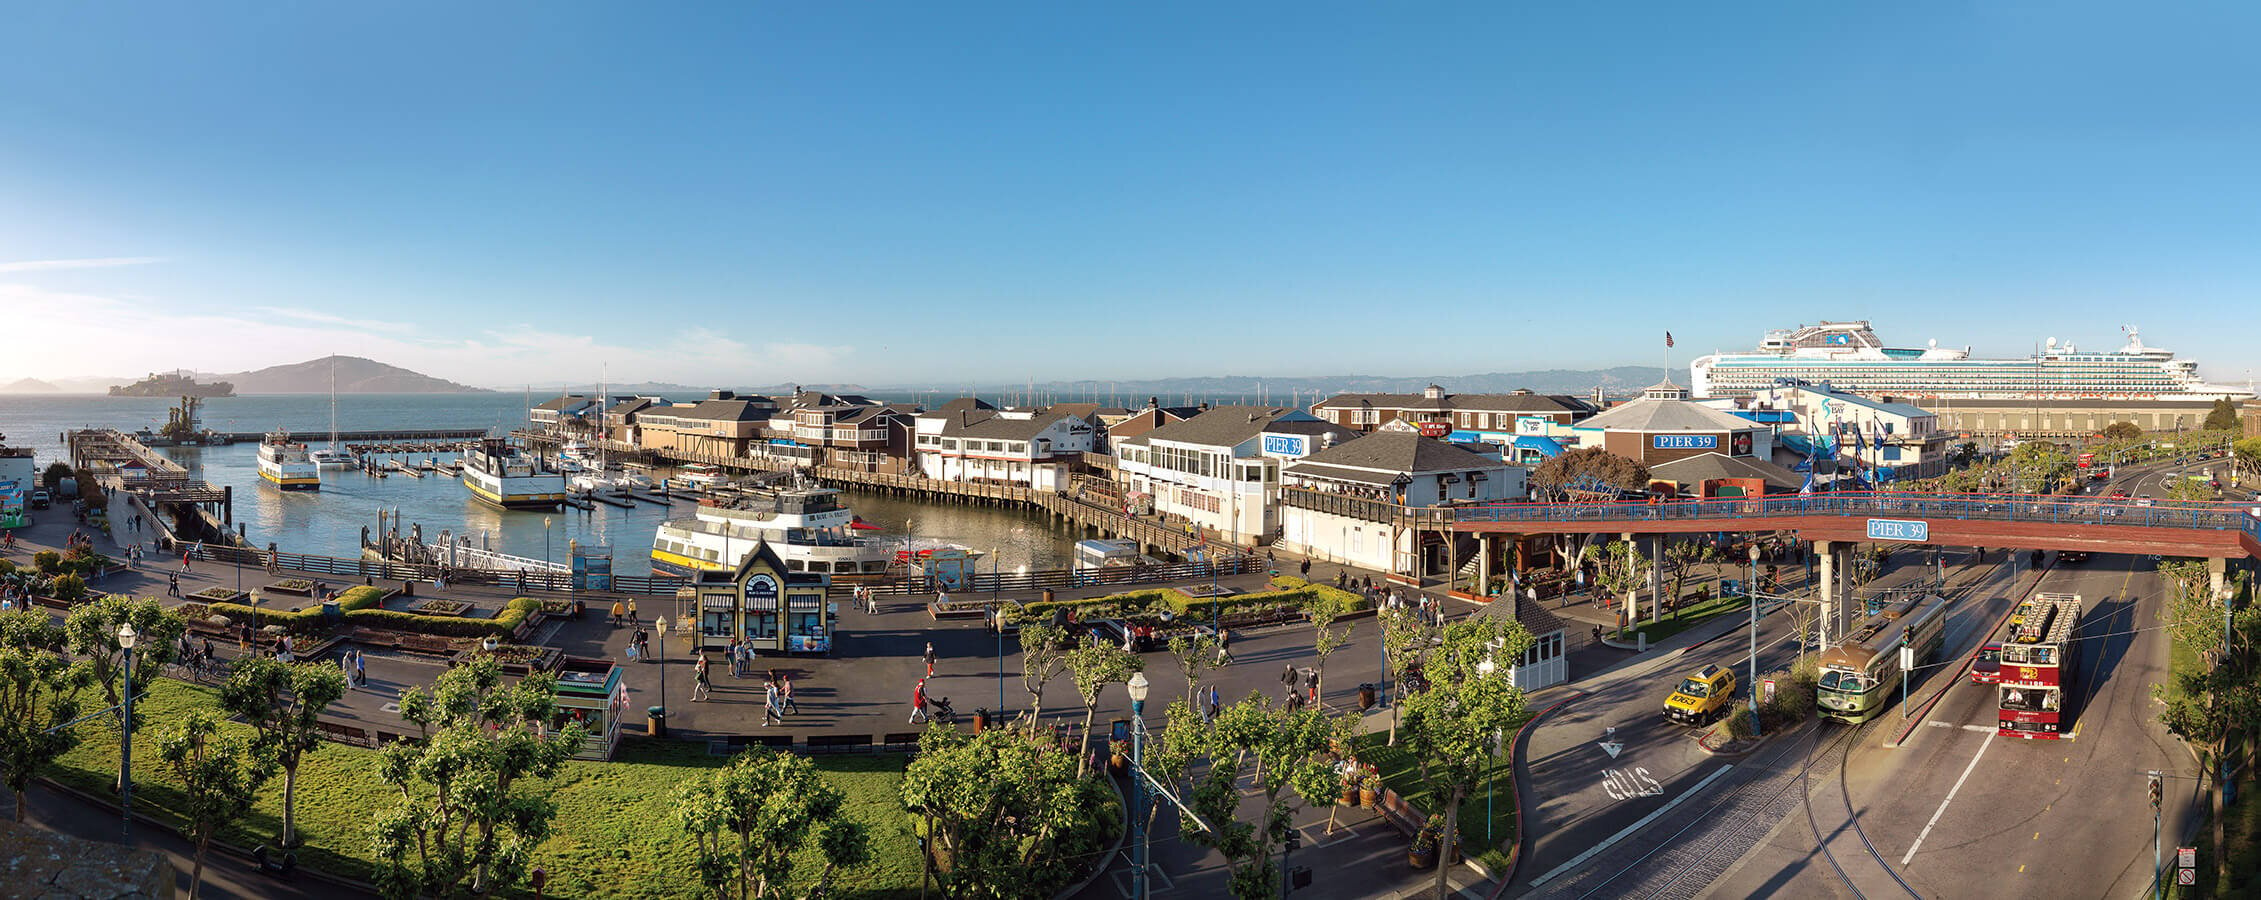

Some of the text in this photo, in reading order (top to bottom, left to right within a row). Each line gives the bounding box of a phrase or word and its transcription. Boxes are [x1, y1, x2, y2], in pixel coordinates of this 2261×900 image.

[1267, 437, 1301, 454] PIER 39
[1660, 437, 1711, 447] PIER 39
[1871, 522, 1924, 538] PIER 39
[1671, 695, 1696, 706] 1063
[1602, 767, 1664, 800] STOP
